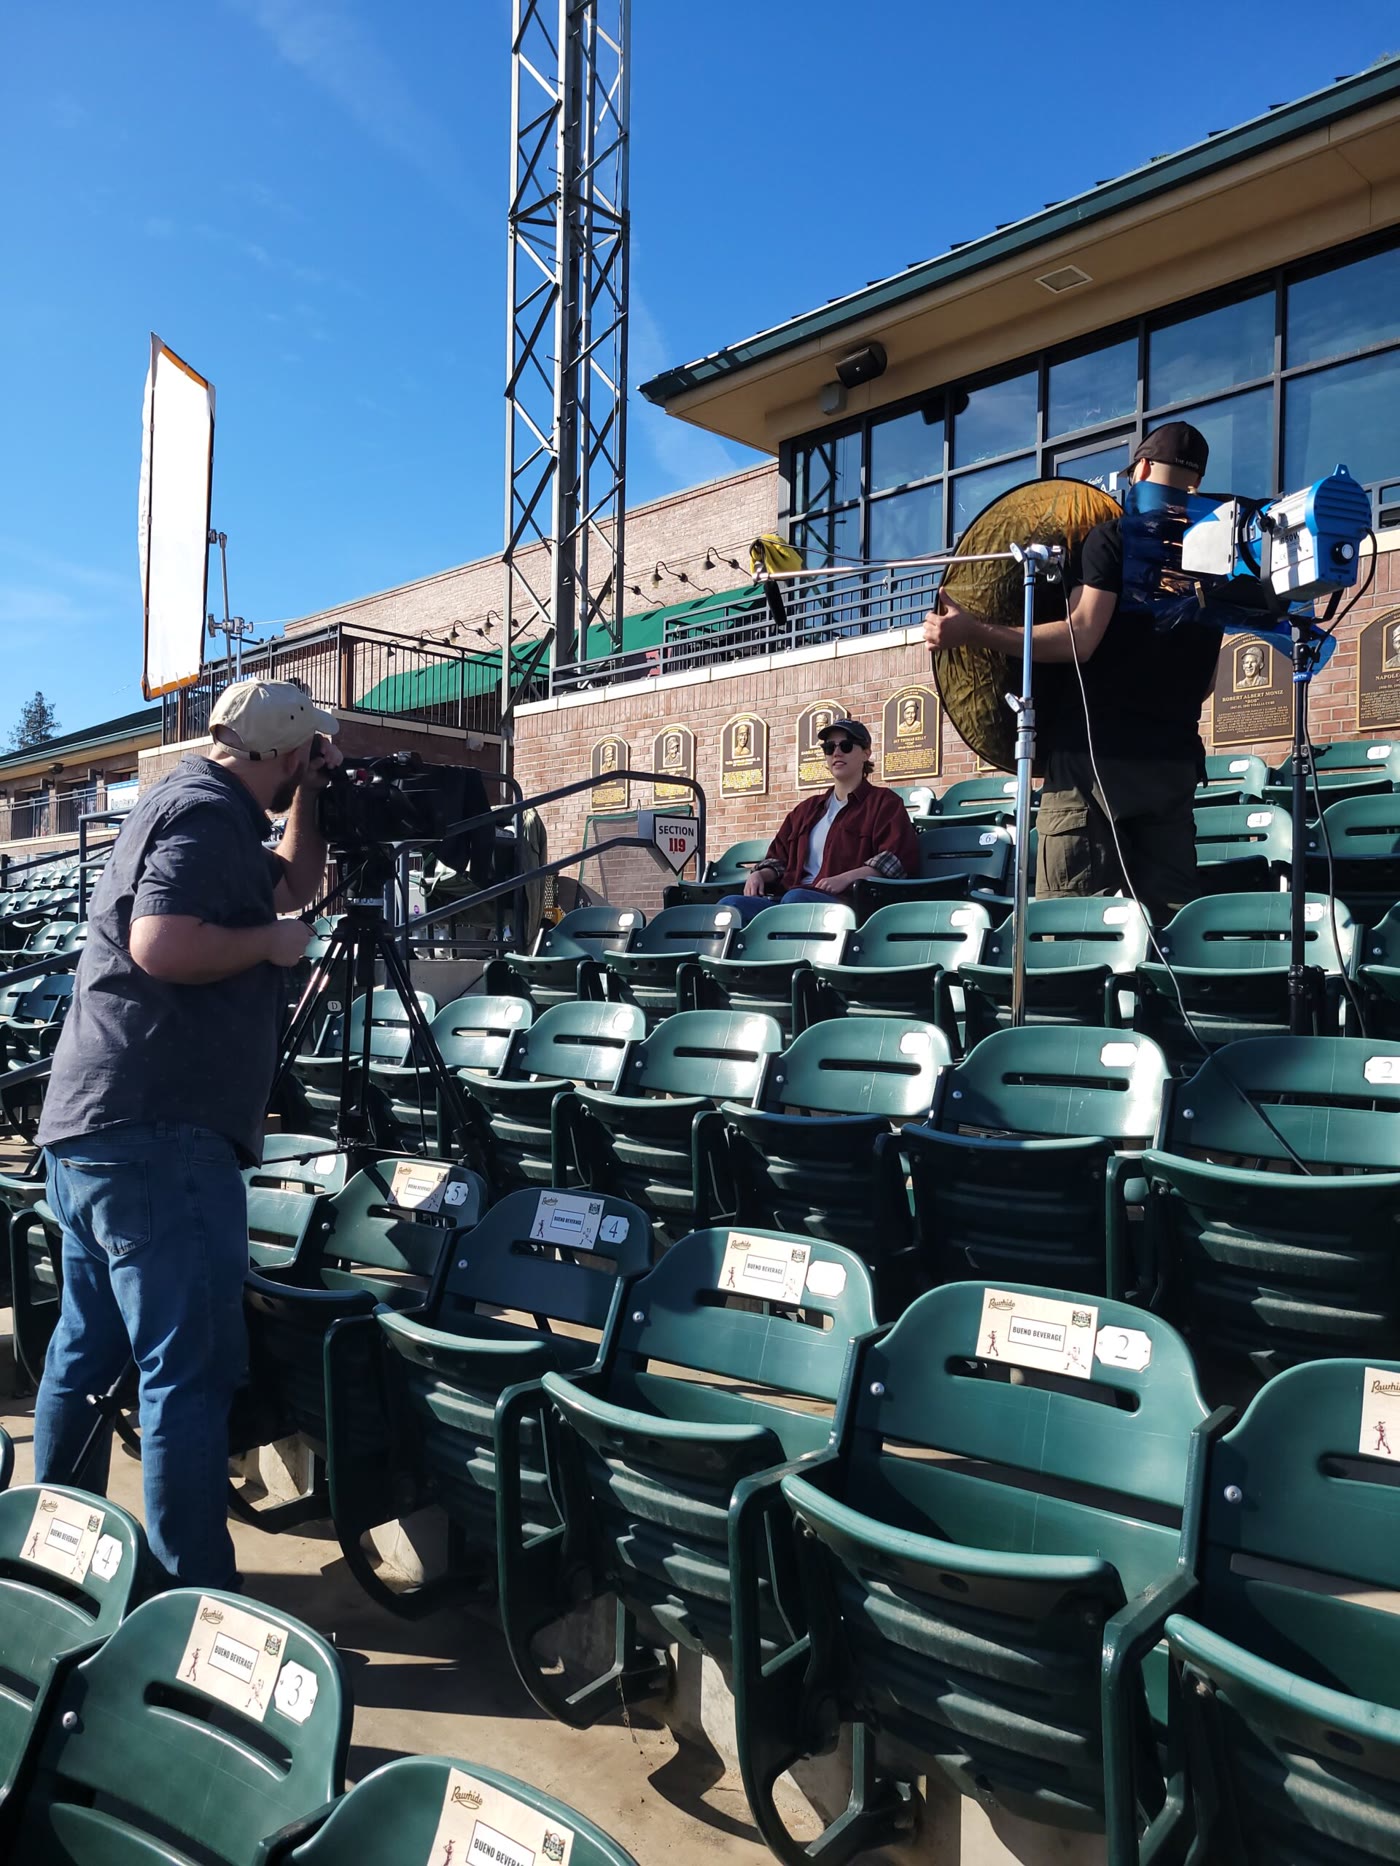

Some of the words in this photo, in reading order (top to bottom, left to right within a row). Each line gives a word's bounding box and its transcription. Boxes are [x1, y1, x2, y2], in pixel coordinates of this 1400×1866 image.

[1222, 694, 1243, 702] ROBERT
[1242, 692, 1265, 700] ALBERT
[1265, 689, 1284, 697] MONIZ
[658, 825, 695, 837] SECTION
[669, 838, 686, 853] 119
[1381, 1061, 1393, 1079] 2
[451, 1185, 461, 1201] 5
[608, 1220, 619, 1239] 4
[747, 1262, 762, 1271] BUENO
[761, 1264, 783, 1275] BEVERAGE
[988, 1297, 1015, 1311] Rawhide
[1012, 1326, 1032, 1336] BUENO
[1032, 1330, 1062, 1342] BEVERAGE
[1114, 1334, 1129, 1360] 2
[50, 1528, 62, 1539] BUENO
[61, 1532, 79, 1546] BEVERAGE
[102, 1544, 114, 1570] 4
[200, 1607, 224, 1625] Rawhide
[214, 1645, 230, 1660] BUENO
[229, 1652, 254, 1671] BEVERAGE
[287, 1674, 303, 1707] 3
[450, 1785, 483, 1810] Rawhide
[473, 1838, 496, 1858] BUENO
